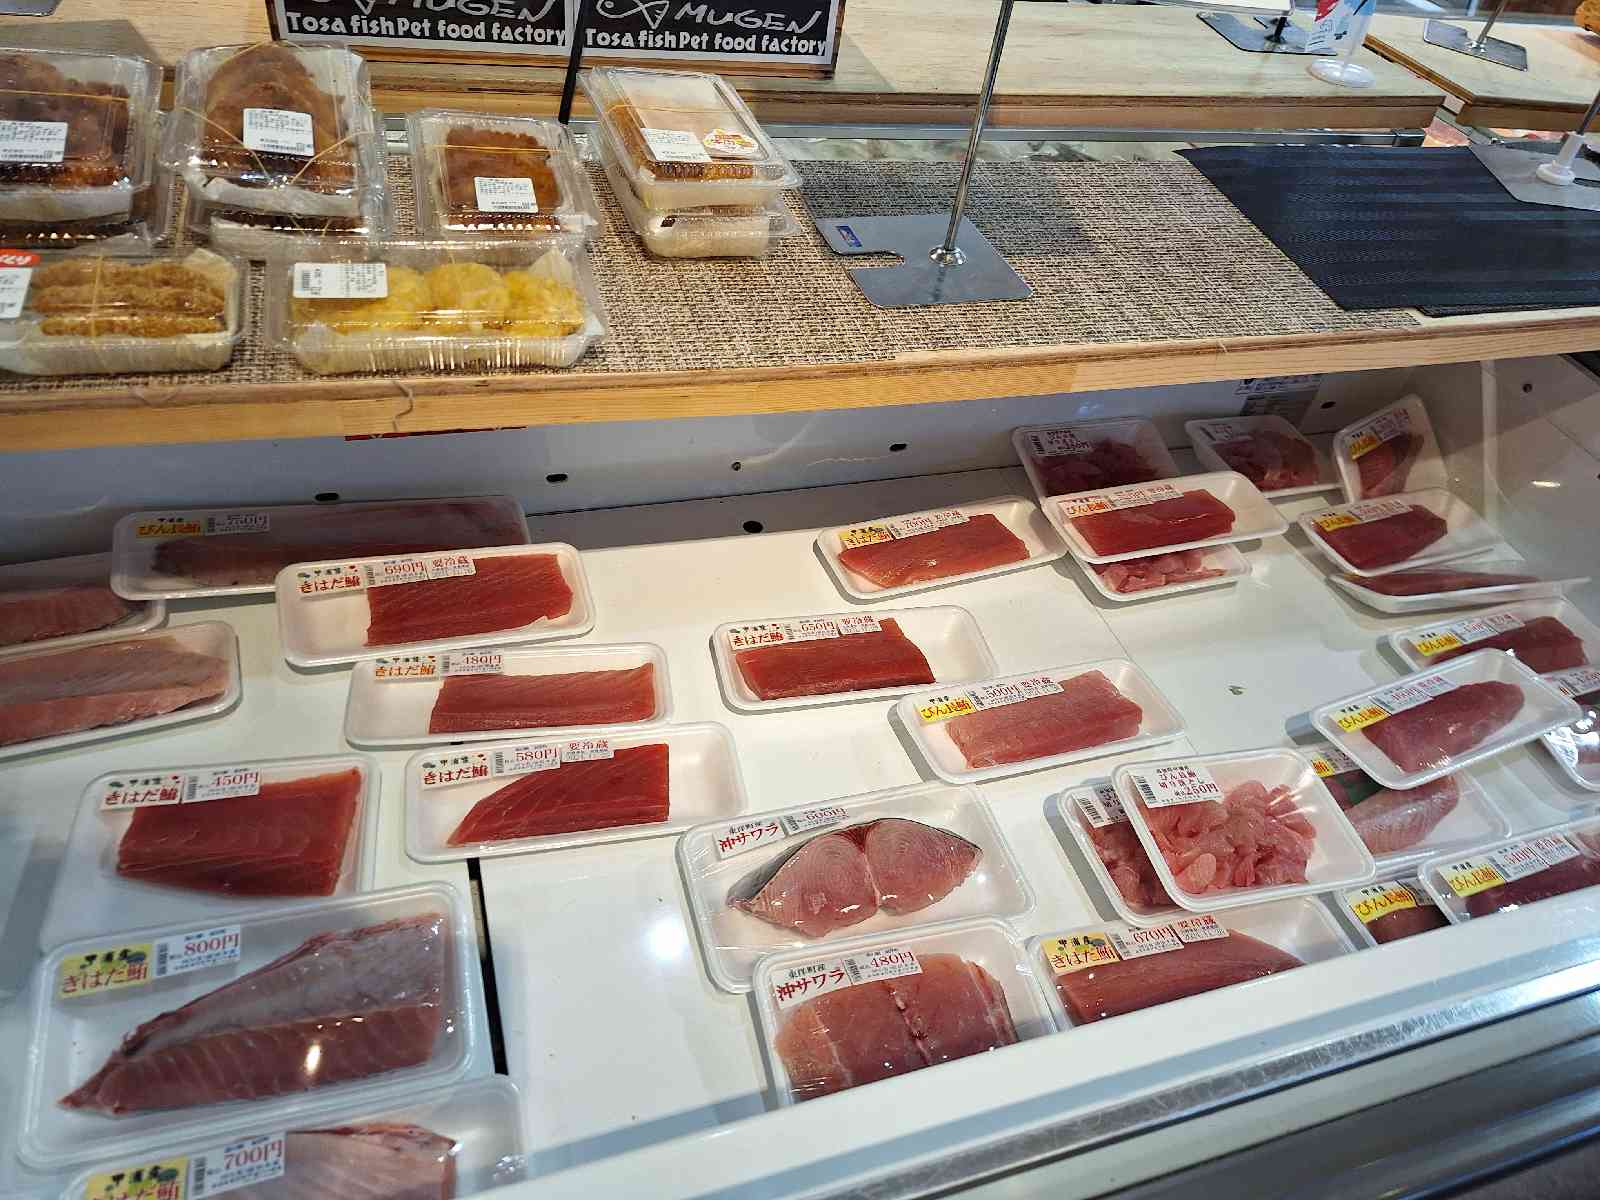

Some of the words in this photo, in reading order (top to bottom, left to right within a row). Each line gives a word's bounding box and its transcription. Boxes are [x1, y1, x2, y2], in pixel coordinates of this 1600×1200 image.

[286, 11, 346, 34] Tosa
[350, 14, 395, 35] fish
[397, 17, 431, 37] Pet
[438, 19, 485, 41] food
[491, 22, 566, 47] factory
[674, 2, 823, 33] MUGEN
[585, 28, 635, 48] Tosa
[637, 30, 677, 49] fish
[678, 31, 709, 50] Pet
[713, 33, 756, 53] food
[761, 35, 827, 57] factory
[299, 575, 361, 593] きはだ鮪
[516, 747, 558, 762] 580円
[423, 765, 488, 785] きはだ鮪
[104, 787, 178, 805] きはだ鮪
[718, 821, 779, 853] 沖サワラ
[183, 932, 241, 956] 800円
[1131, 924, 1176, 944] 670円
[871, 950, 916, 968] 480円
[1050, 944, 1117, 969] きはだ鮪
[62, 963, 148, 994] きはだ鮪
[775, 967, 846, 1002] 沖サワラ
[224, 1138, 284, 1170] 700円
